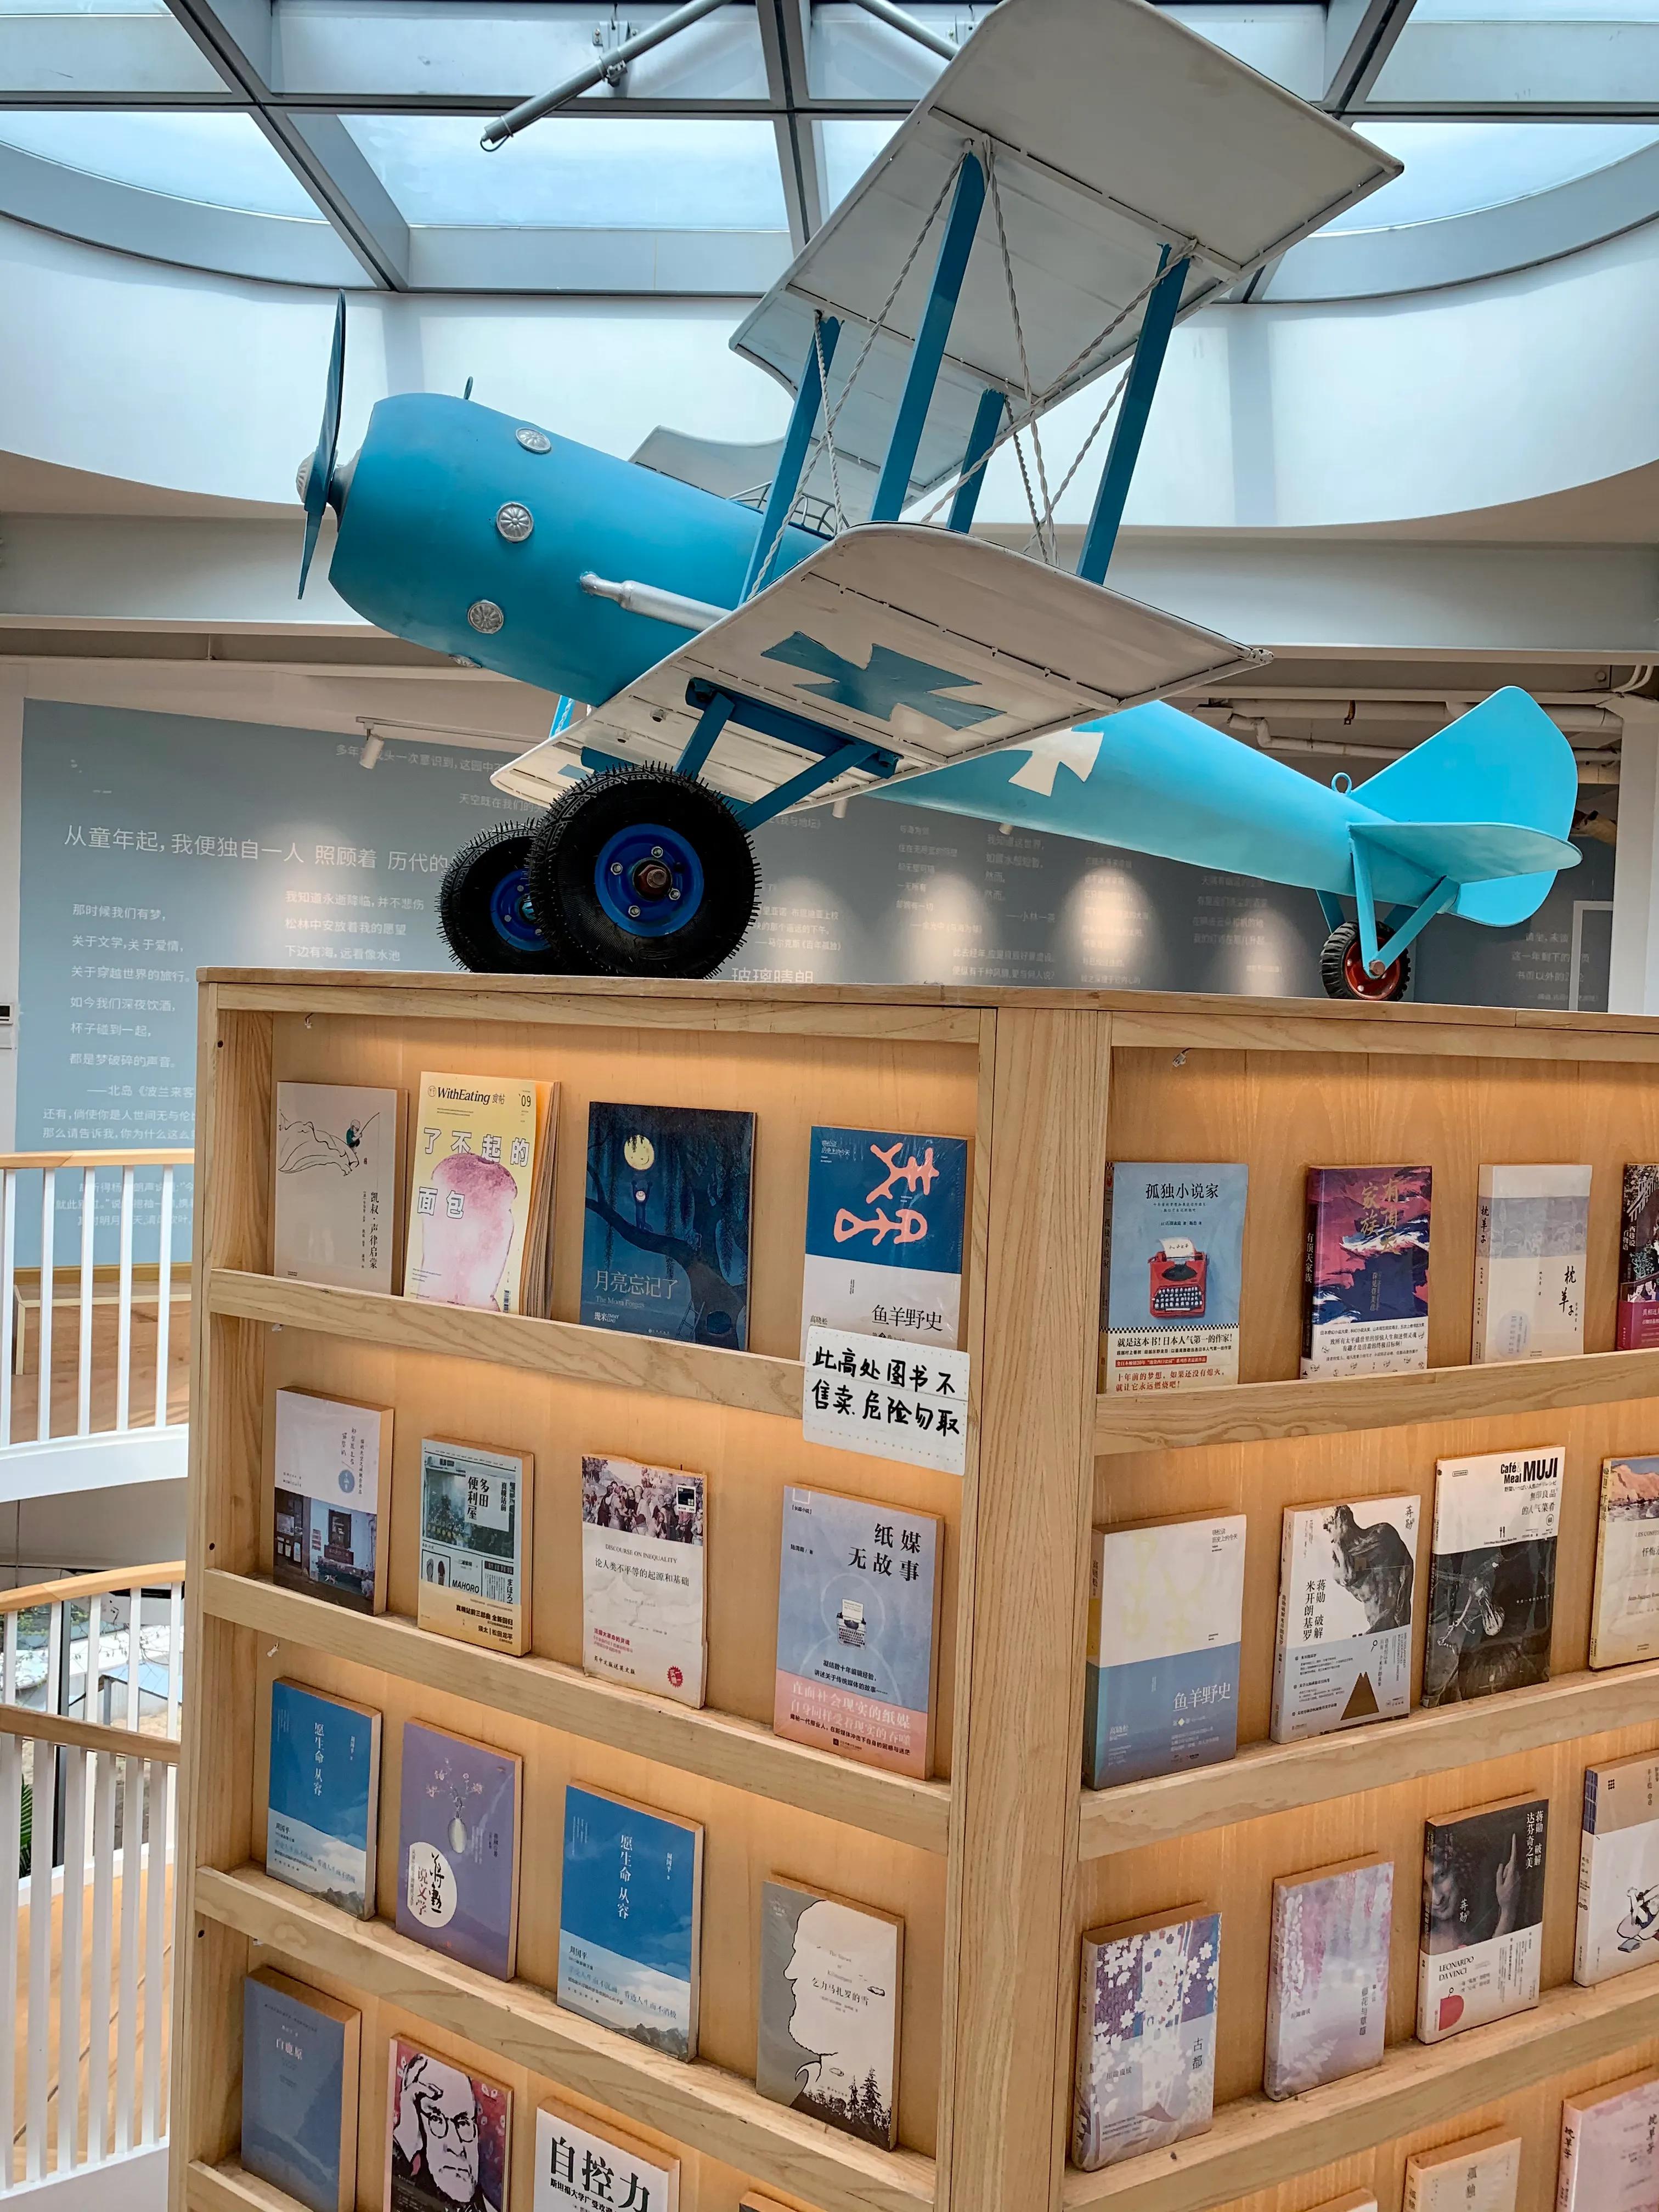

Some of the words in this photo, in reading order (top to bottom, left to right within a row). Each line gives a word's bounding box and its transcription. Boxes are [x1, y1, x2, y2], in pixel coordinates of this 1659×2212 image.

[64, 824, 305, 865] 从童年起，我便独自一人
[314, 844, 377, 869] 照顾着
[72, 903, 166, 922] 那时候我们有梦，
[71, 966, 191, 983] 关于穿越世界的旅行。
[70, 1022, 152, 1037] 杯子碰到一起，
[70, 1053, 176, 1068] 都是梦破碎的声音。
[438, 1087, 490, 1105] WithEating
[424, 1127, 529, 1167] 了不起的
[417, 1186, 465, 1219] 面包
[1146, 1183, 1220, 1199] 孤独小说家
[1305, 1232, 1314, 1283] 有顶天家族
[594, 1270, 679, 1300] 月亮忘记了
[1559, 1265, 1576, 1316] 枕草子
[596, 1295, 607, 1304] The
[608, 1297, 624, 1306] Moon
[871, 1304, 944, 1331] 鱼羊野史
[1117, 1333, 1233, 1347] 就是这本书！日本人气第一的作家！
[812, 1346, 955, 1395] 此高处图书不
[1500, 1462, 1517, 1474] Café
[1504, 1473, 1522, 1484] Meal
[1523, 1457, 1558, 1482] MUJI
[467, 1476, 479, 1520] 便利屋
[479, 1478, 489, 1508] 多田
[874, 1522, 922, 1554] 纸媒
[595, 1557, 690, 1587] 论人类不平等的起源和基础
[643, 1553, 678, 1564] INEQUALITY
[848, 1546, 920, 1582] 无故事
[452, 1579, 479, 1594] MAHORO
[1316, 1579, 1326, 1604] 蒋勋
[1302, 1580, 1315, 1641] 米开朗基罗
[1314, 1614, 1324, 1639] 破解
[792, 1680, 910, 1729] 直面社会现实的纸媒
[1172, 1681, 1231, 1712] 鱼羊野史
[314, 1722, 324, 1764] 愿生命
[314, 1767, 323, 1796] 从容
[1535, 1810, 1544, 1833] 蒋勋
[1525, 1812, 1535, 1869] 达芬奇之美
[1534, 1843, 1542, 1866] 破解
[620, 1835, 633, 1883] 愿生命
[617, 1887, 630, 1920] 从容
[1439, 1956, 1474, 1972] LEONARDO
[812, 1977, 870, 2006] 乞力马扎罗的雪
[1192, 2036, 1203, 2070] 古都
[551, 2136, 651, 2212] 自控力
